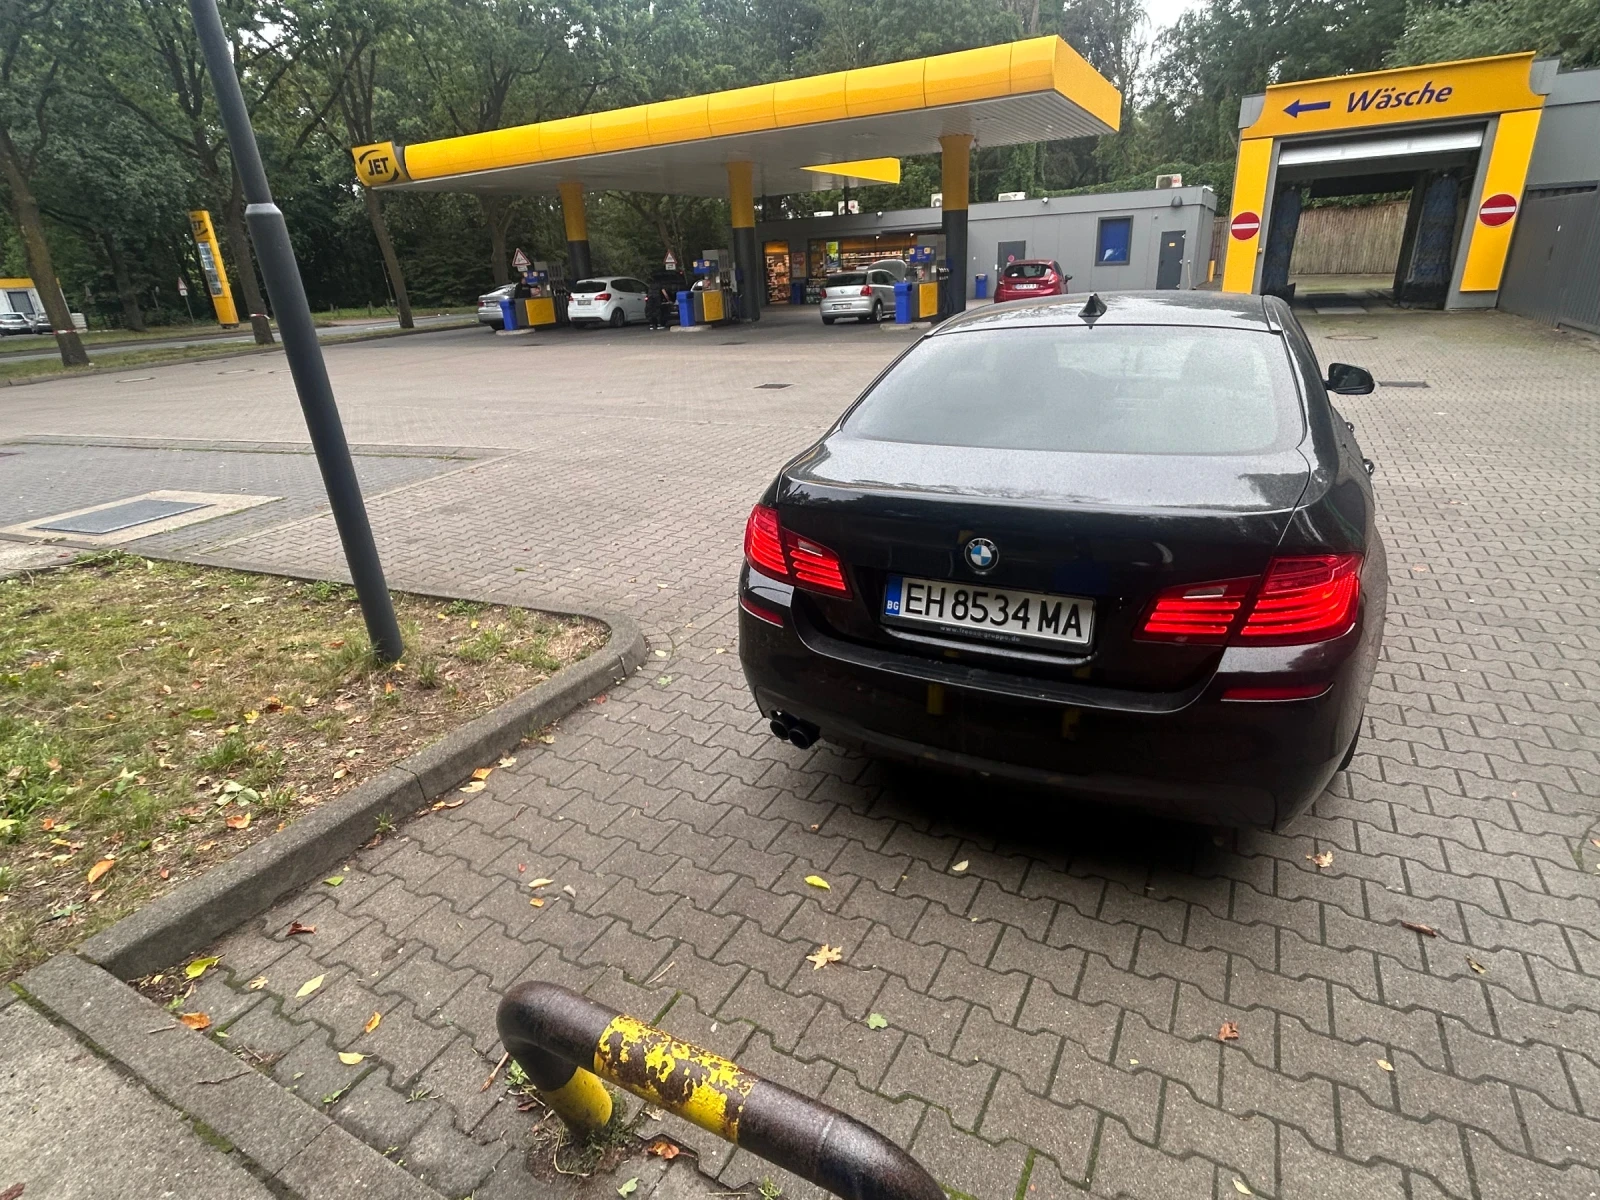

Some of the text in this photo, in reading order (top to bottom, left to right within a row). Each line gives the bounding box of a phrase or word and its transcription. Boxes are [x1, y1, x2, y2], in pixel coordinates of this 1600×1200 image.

[1346, 80, 1453, 113] Wäsche
[368, 157, 388, 176] JET
[886, 599, 899, 611] BG
[905, 583, 1082, 638] EH 8534 MA
